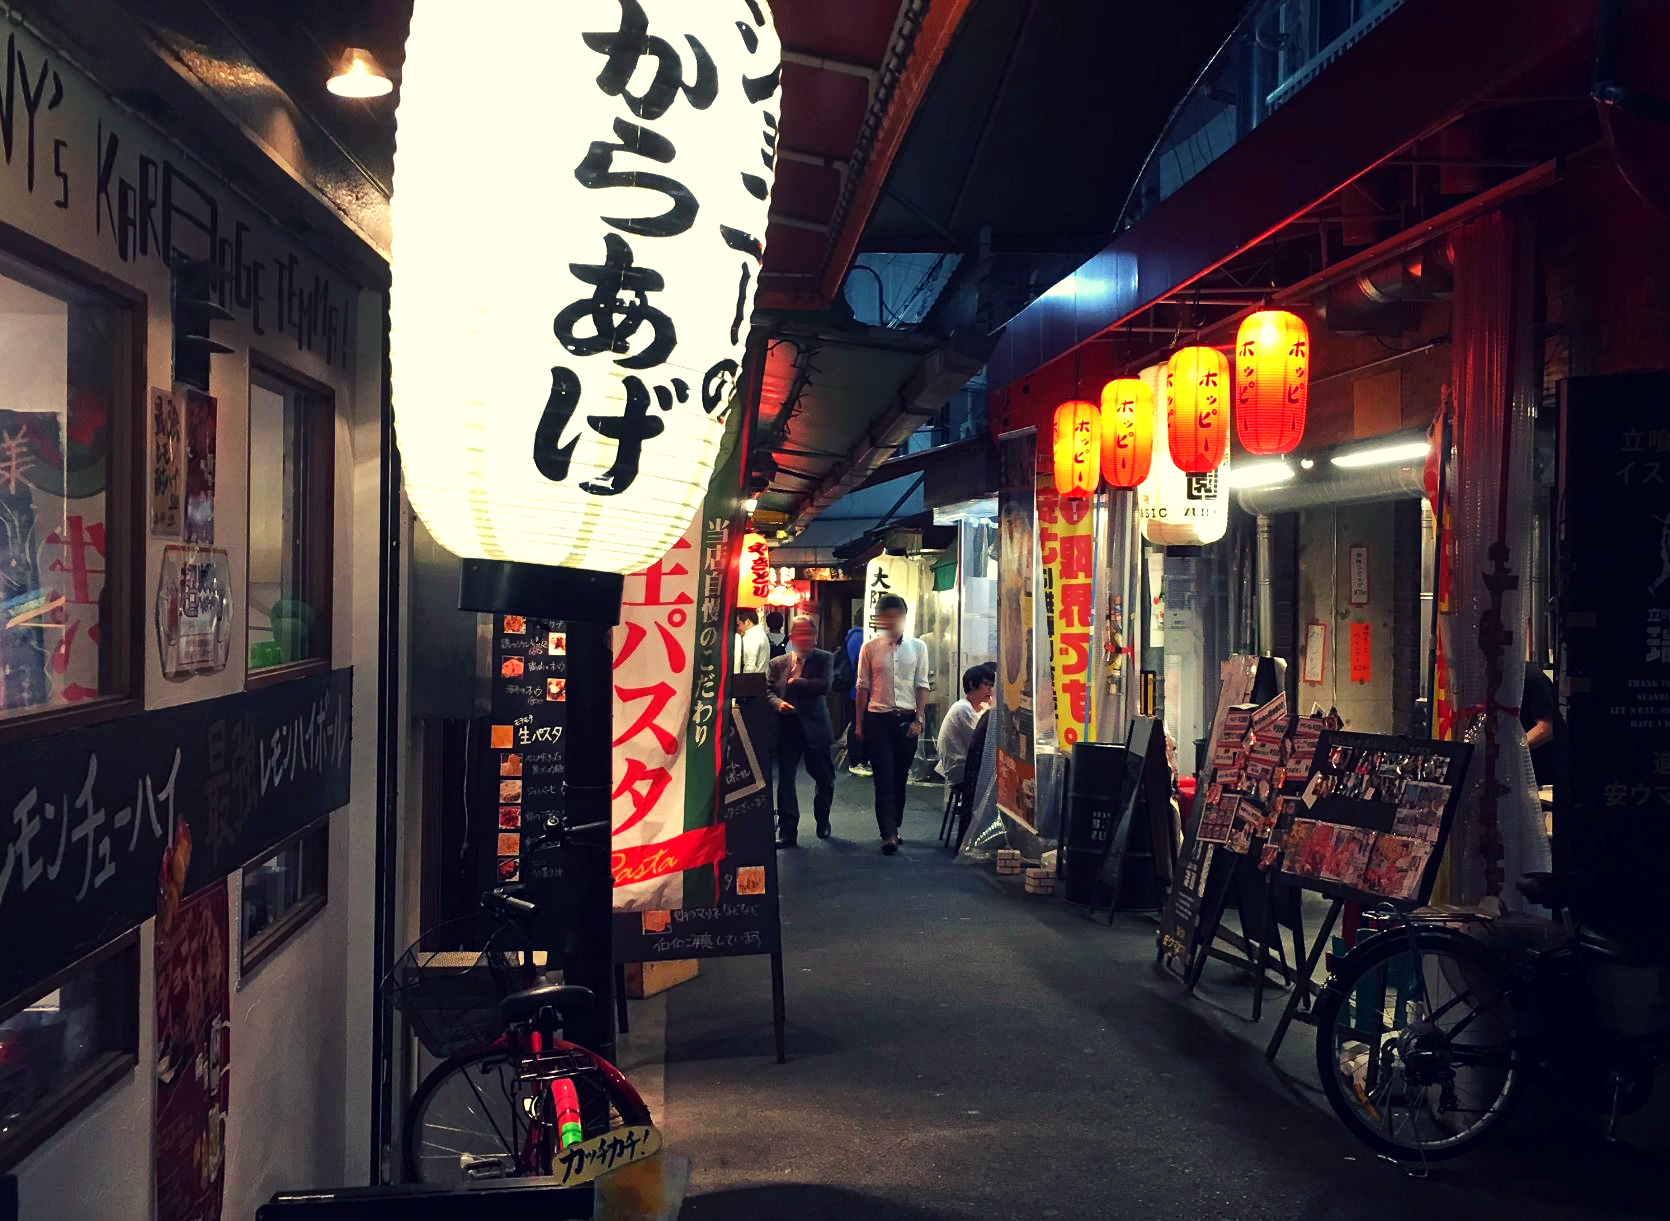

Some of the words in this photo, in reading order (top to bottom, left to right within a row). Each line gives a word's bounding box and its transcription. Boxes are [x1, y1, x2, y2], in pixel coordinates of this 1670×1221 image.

[533, 0, 720, 496] からあげ
[518, 725, 563, 745] 生パスタ
[610, 536, 695, 838] 生パスタ
